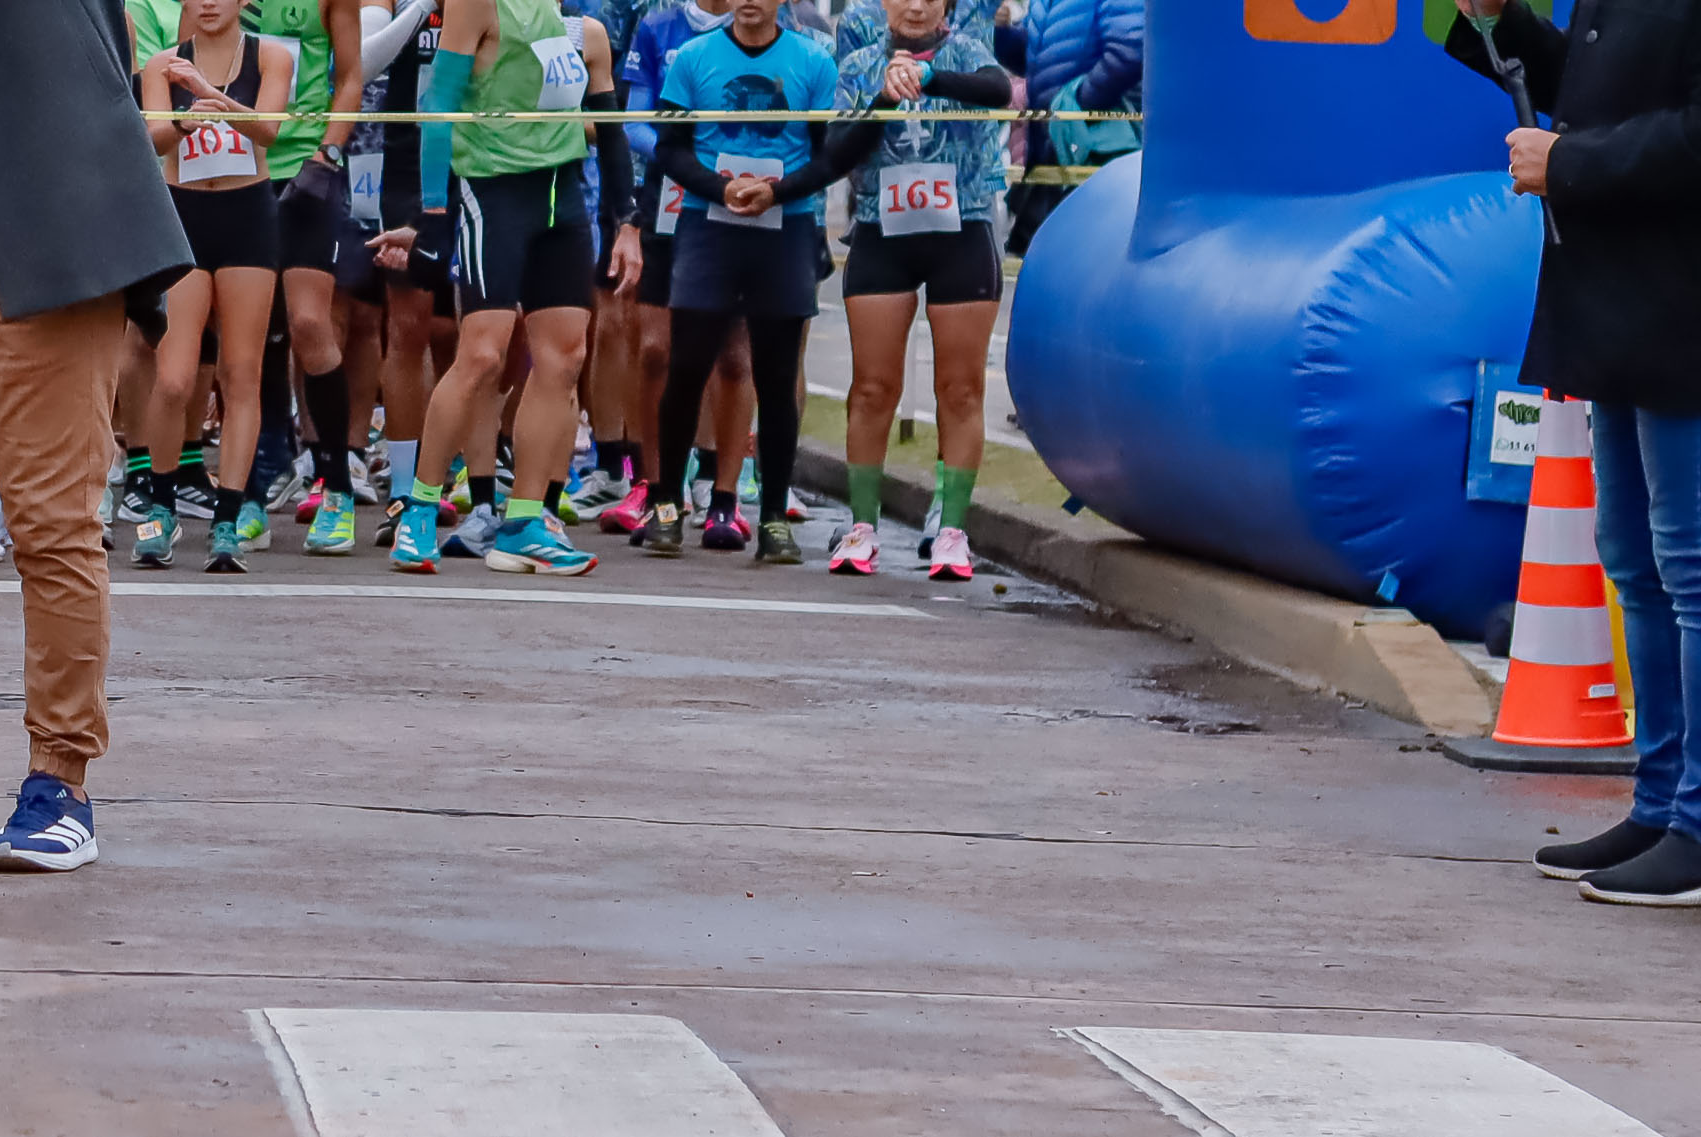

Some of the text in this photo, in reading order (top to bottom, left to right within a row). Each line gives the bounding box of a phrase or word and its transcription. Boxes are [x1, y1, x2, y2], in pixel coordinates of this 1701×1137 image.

[418, 27, 442, 49] AT
[545, 51, 585, 88] 415
[183, 126, 248, 162] 101
[887, 179, 954, 213] 165
